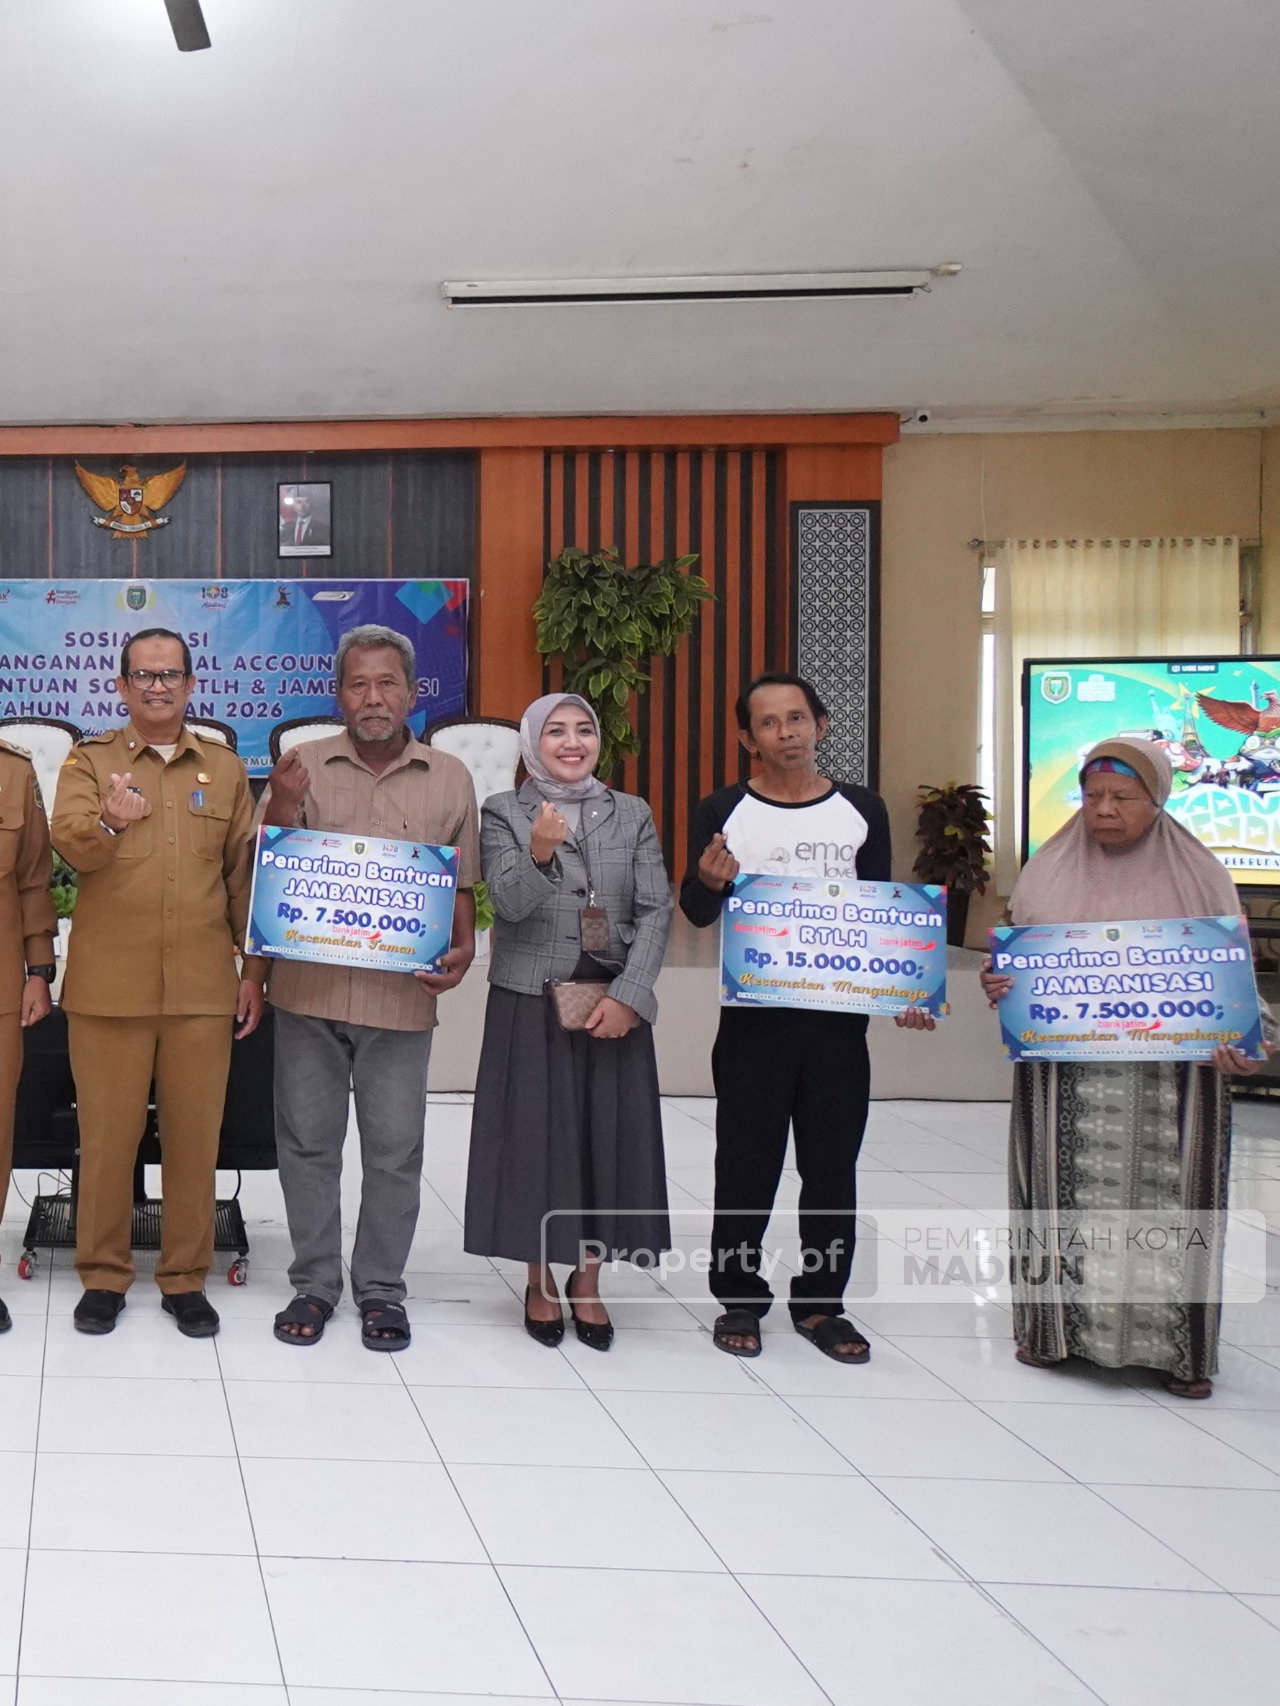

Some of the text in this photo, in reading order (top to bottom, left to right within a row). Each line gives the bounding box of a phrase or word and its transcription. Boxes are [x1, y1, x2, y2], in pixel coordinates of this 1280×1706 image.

[233, 653, 333, 671] ACCOUN
[196, 678, 239, 695] TLH
[251, 678, 266, 695] &
[81, 700, 215, 718] ANGAN
[225, 701, 283, 719] 2026
[261, 850, 454, 889] Penerima Bantuan
[823, 863, 854, 878] love
[283, 877, 426, 911] JAMBANISASI
[277, 902, 427, 938] Rp. 7.500.000;
[727, 896, 944, 928] Penerima Bantuan
[284, 928, 417, 956] Kecamatan Taman
[799, 924, 868, 949] RTLH
[744, 947, 925, 980] Rp. 15.000.000;
[995, 944, 1247, 971] Penerima Bantuan
[738, 972, 930, 1002] Kecamatan Manguharjo
[1031, 970, 1215, 997] JAMBANISASI
[1028, 999, 1225, 1024] Rp. 7.500.000;
[1019, 1030, 1118, 1043] Kecamatan
